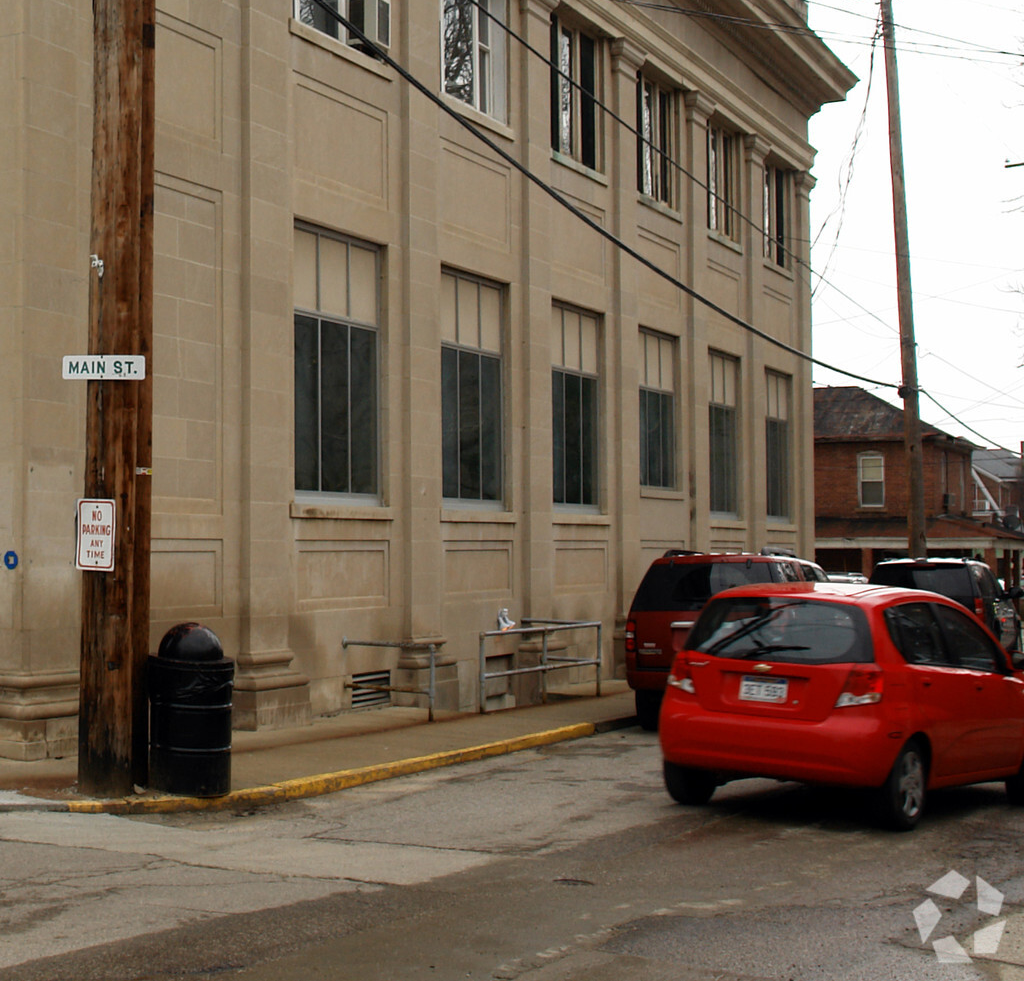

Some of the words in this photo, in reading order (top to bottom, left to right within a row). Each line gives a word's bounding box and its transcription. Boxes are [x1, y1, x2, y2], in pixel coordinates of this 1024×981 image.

[68, 361, 106, 374] MAIN
[113, 361, 138, 374] ST.
[91, 510, 103, 521] NO
[82, 524, 111, 536] PARKING
[90, 539, 103, 548] ANY
[86, 550, 105, 560] TIME
